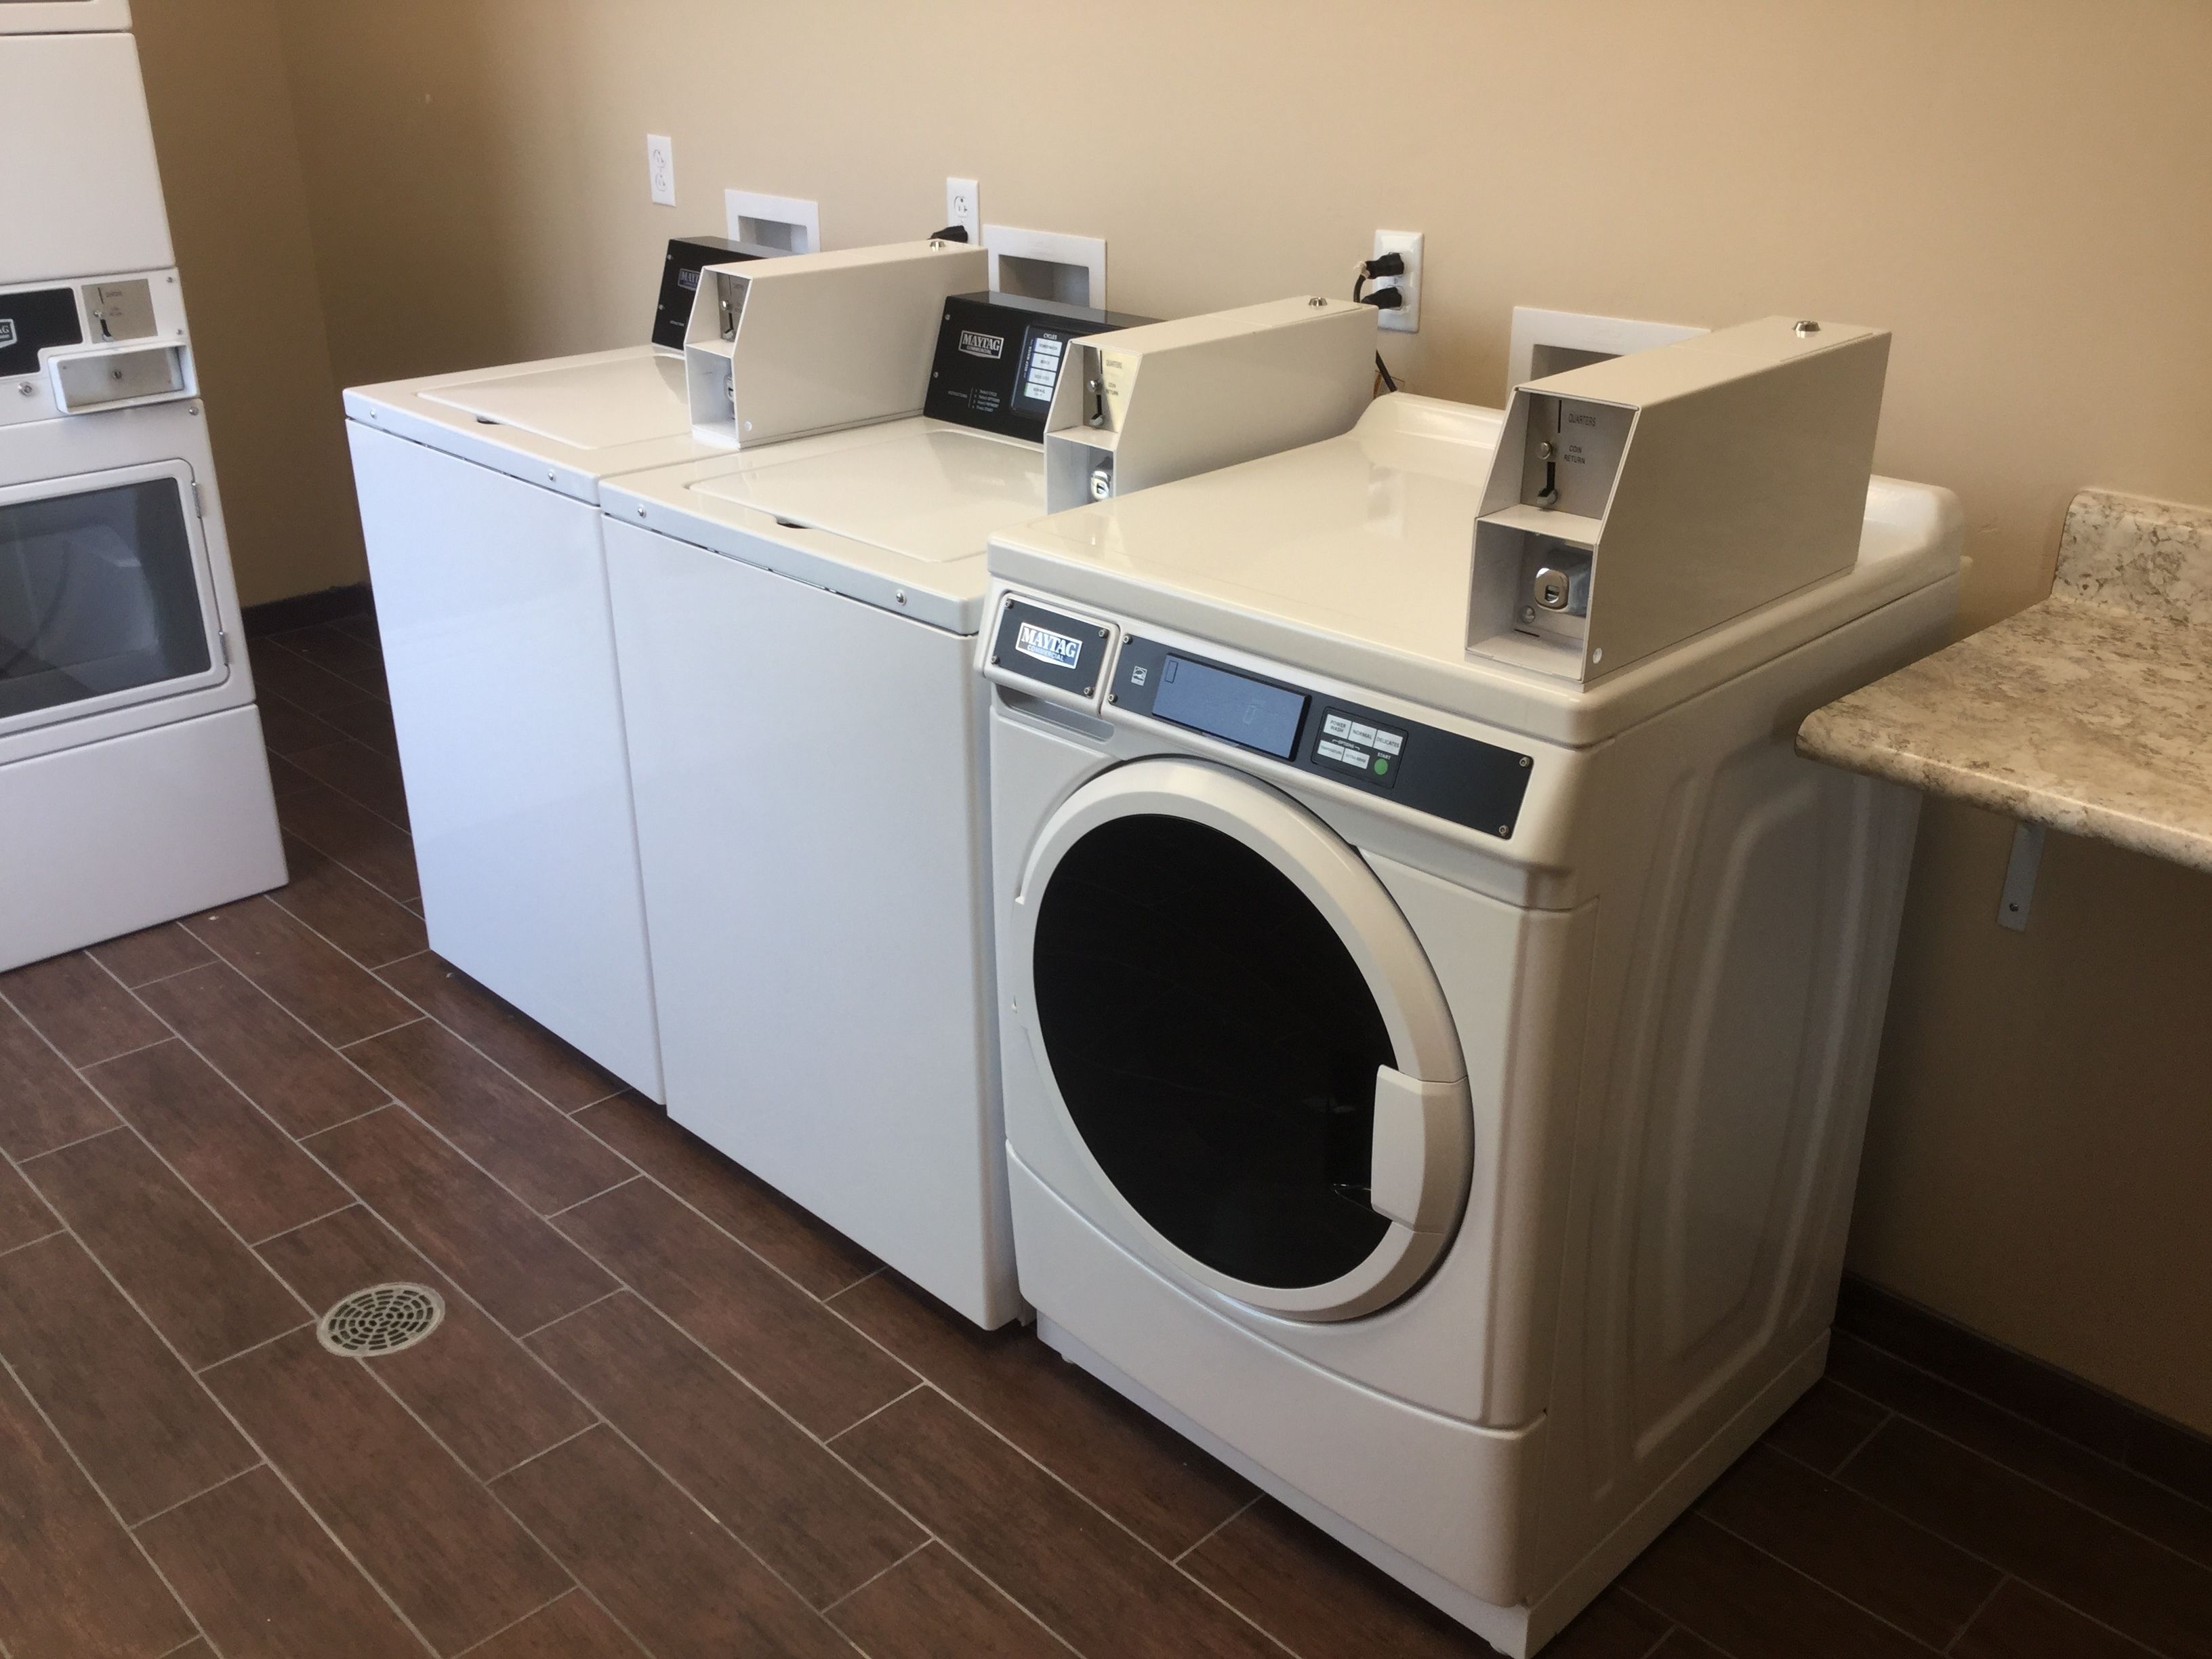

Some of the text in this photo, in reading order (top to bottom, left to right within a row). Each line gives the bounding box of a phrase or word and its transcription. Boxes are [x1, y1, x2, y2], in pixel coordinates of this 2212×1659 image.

[962, 333, 1000, 351] MAYTAG
[1568, 413, 1597, 426] QUARTERS
[1569, 445, 1582, 453] COIN
[1564, 454, 1586, 465] RETURN
[1021, 627, 1077, 658] MAYTAG
[1027, 644, 1064, 661] COMMERCIAL
[1353, 729, 1372, 739] NORMAL
[1376, 737, 1399, 748] DELICATES
[1377, 752, 1391, 760] START
